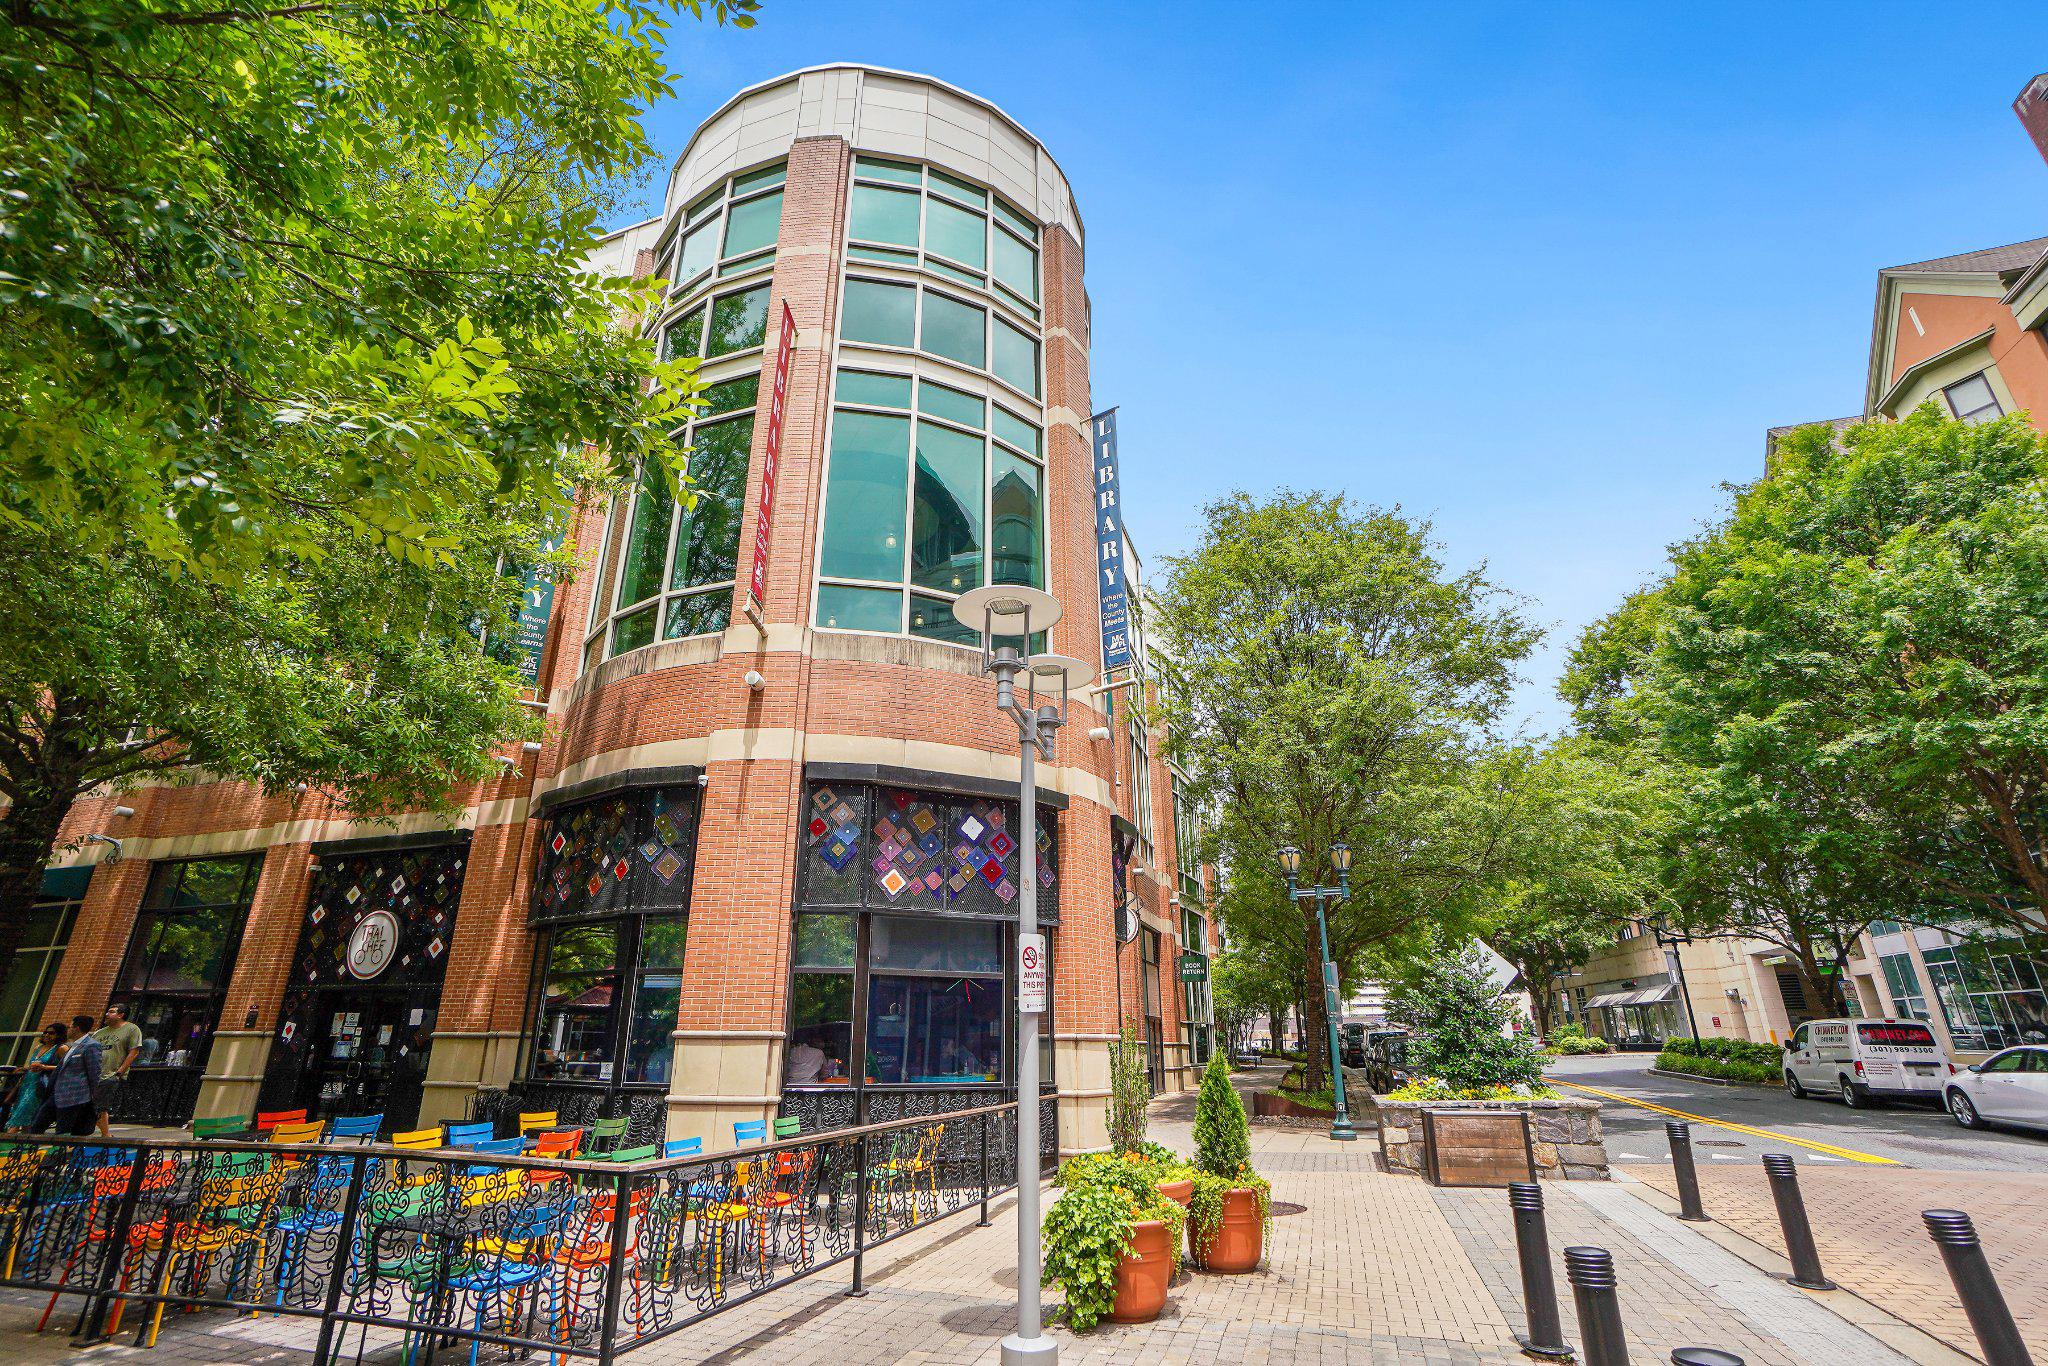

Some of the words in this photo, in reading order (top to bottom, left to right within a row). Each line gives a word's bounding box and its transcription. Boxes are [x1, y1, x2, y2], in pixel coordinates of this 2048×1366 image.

[764, 318, 789, 506] LIBRARY
[1098, 418, 1119, 587] LIBRARY
[1102, 592, 1123, 603] Where
[1107, 602, 1118, 610] the
[521, 613, 546, 624] Where
[1102, 608, 1125, 620] County
[526, 623, 538, 631] the
[1023, 981, 1036, 989] THIS
[1869, 1045, 1893, 1054] (301)
[1894, 1046, 1934, 1054] 989-3300
